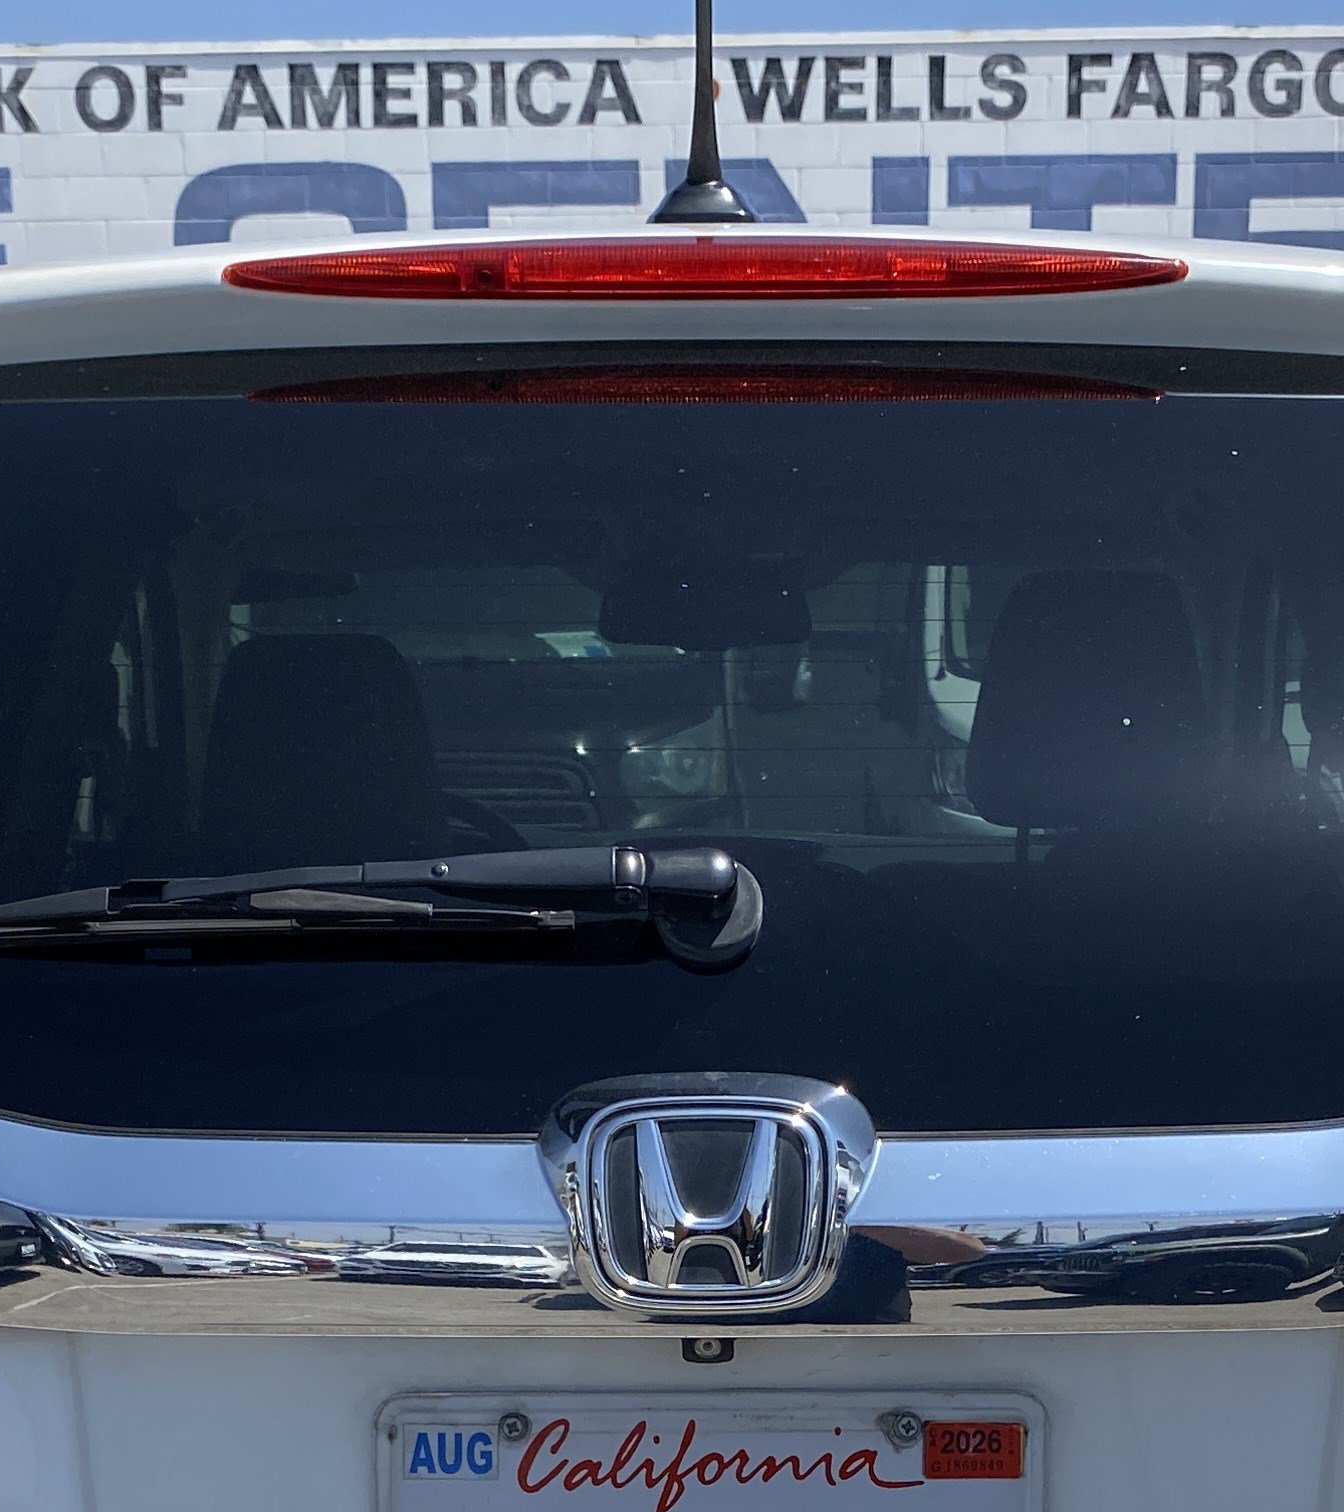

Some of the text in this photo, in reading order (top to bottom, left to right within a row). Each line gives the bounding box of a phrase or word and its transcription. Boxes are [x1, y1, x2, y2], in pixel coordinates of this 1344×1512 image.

[74, 62, 188, 134] OF
[217, 58, 643, 132] AMERICA
[730, 52, 1028, 124] WELLS
[409, 1431, 494, 1476] AUG
[940, 1429, 1003, 1455] 2026
